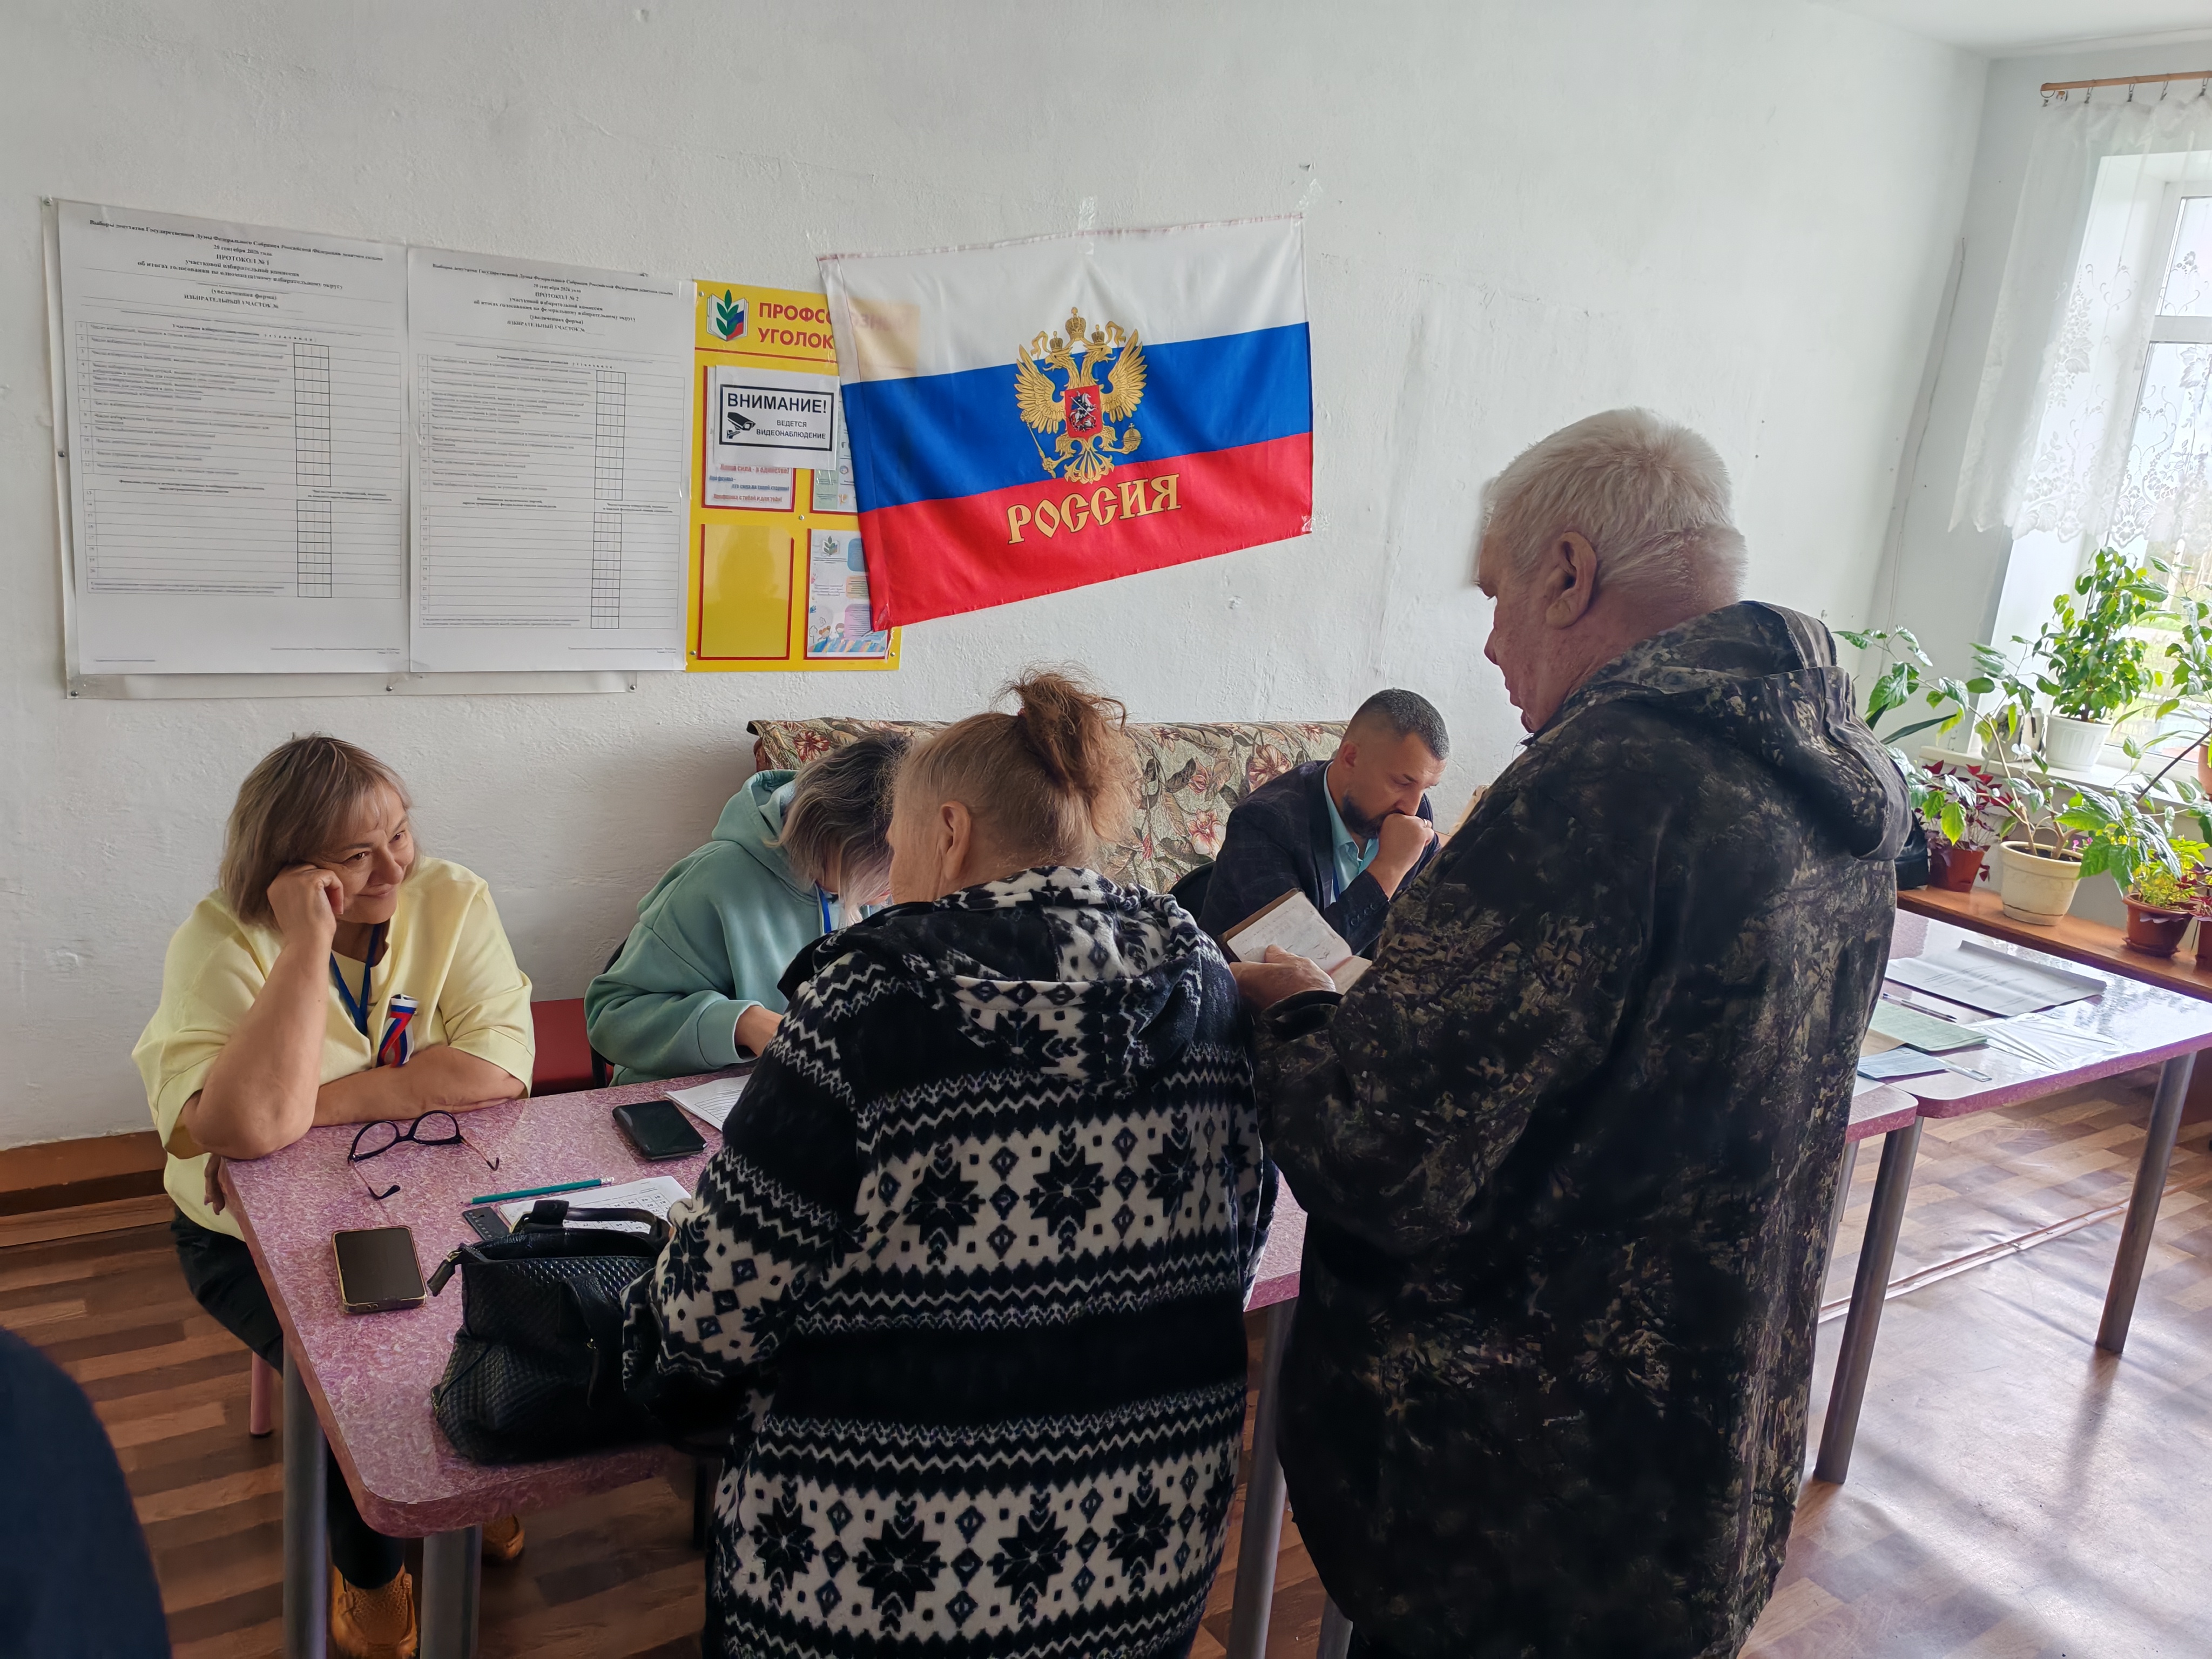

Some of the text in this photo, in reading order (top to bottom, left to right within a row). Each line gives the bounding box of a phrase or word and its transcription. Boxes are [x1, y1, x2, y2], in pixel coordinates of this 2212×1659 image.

[217, 254, 256, 263] ПРОТОКОЛ
[758, 327, 834, 349] УГОЛОК
[728, 393, 826, 413] ВНИМАНИЕ!
[777, 420, 807, 428] ВЕДЕТСЯ
[757, 429, 826, 439] ВИДЕОНАБЛЮДЕНИЕ
[1007, 474, 1181, 544] РОССИЯ
